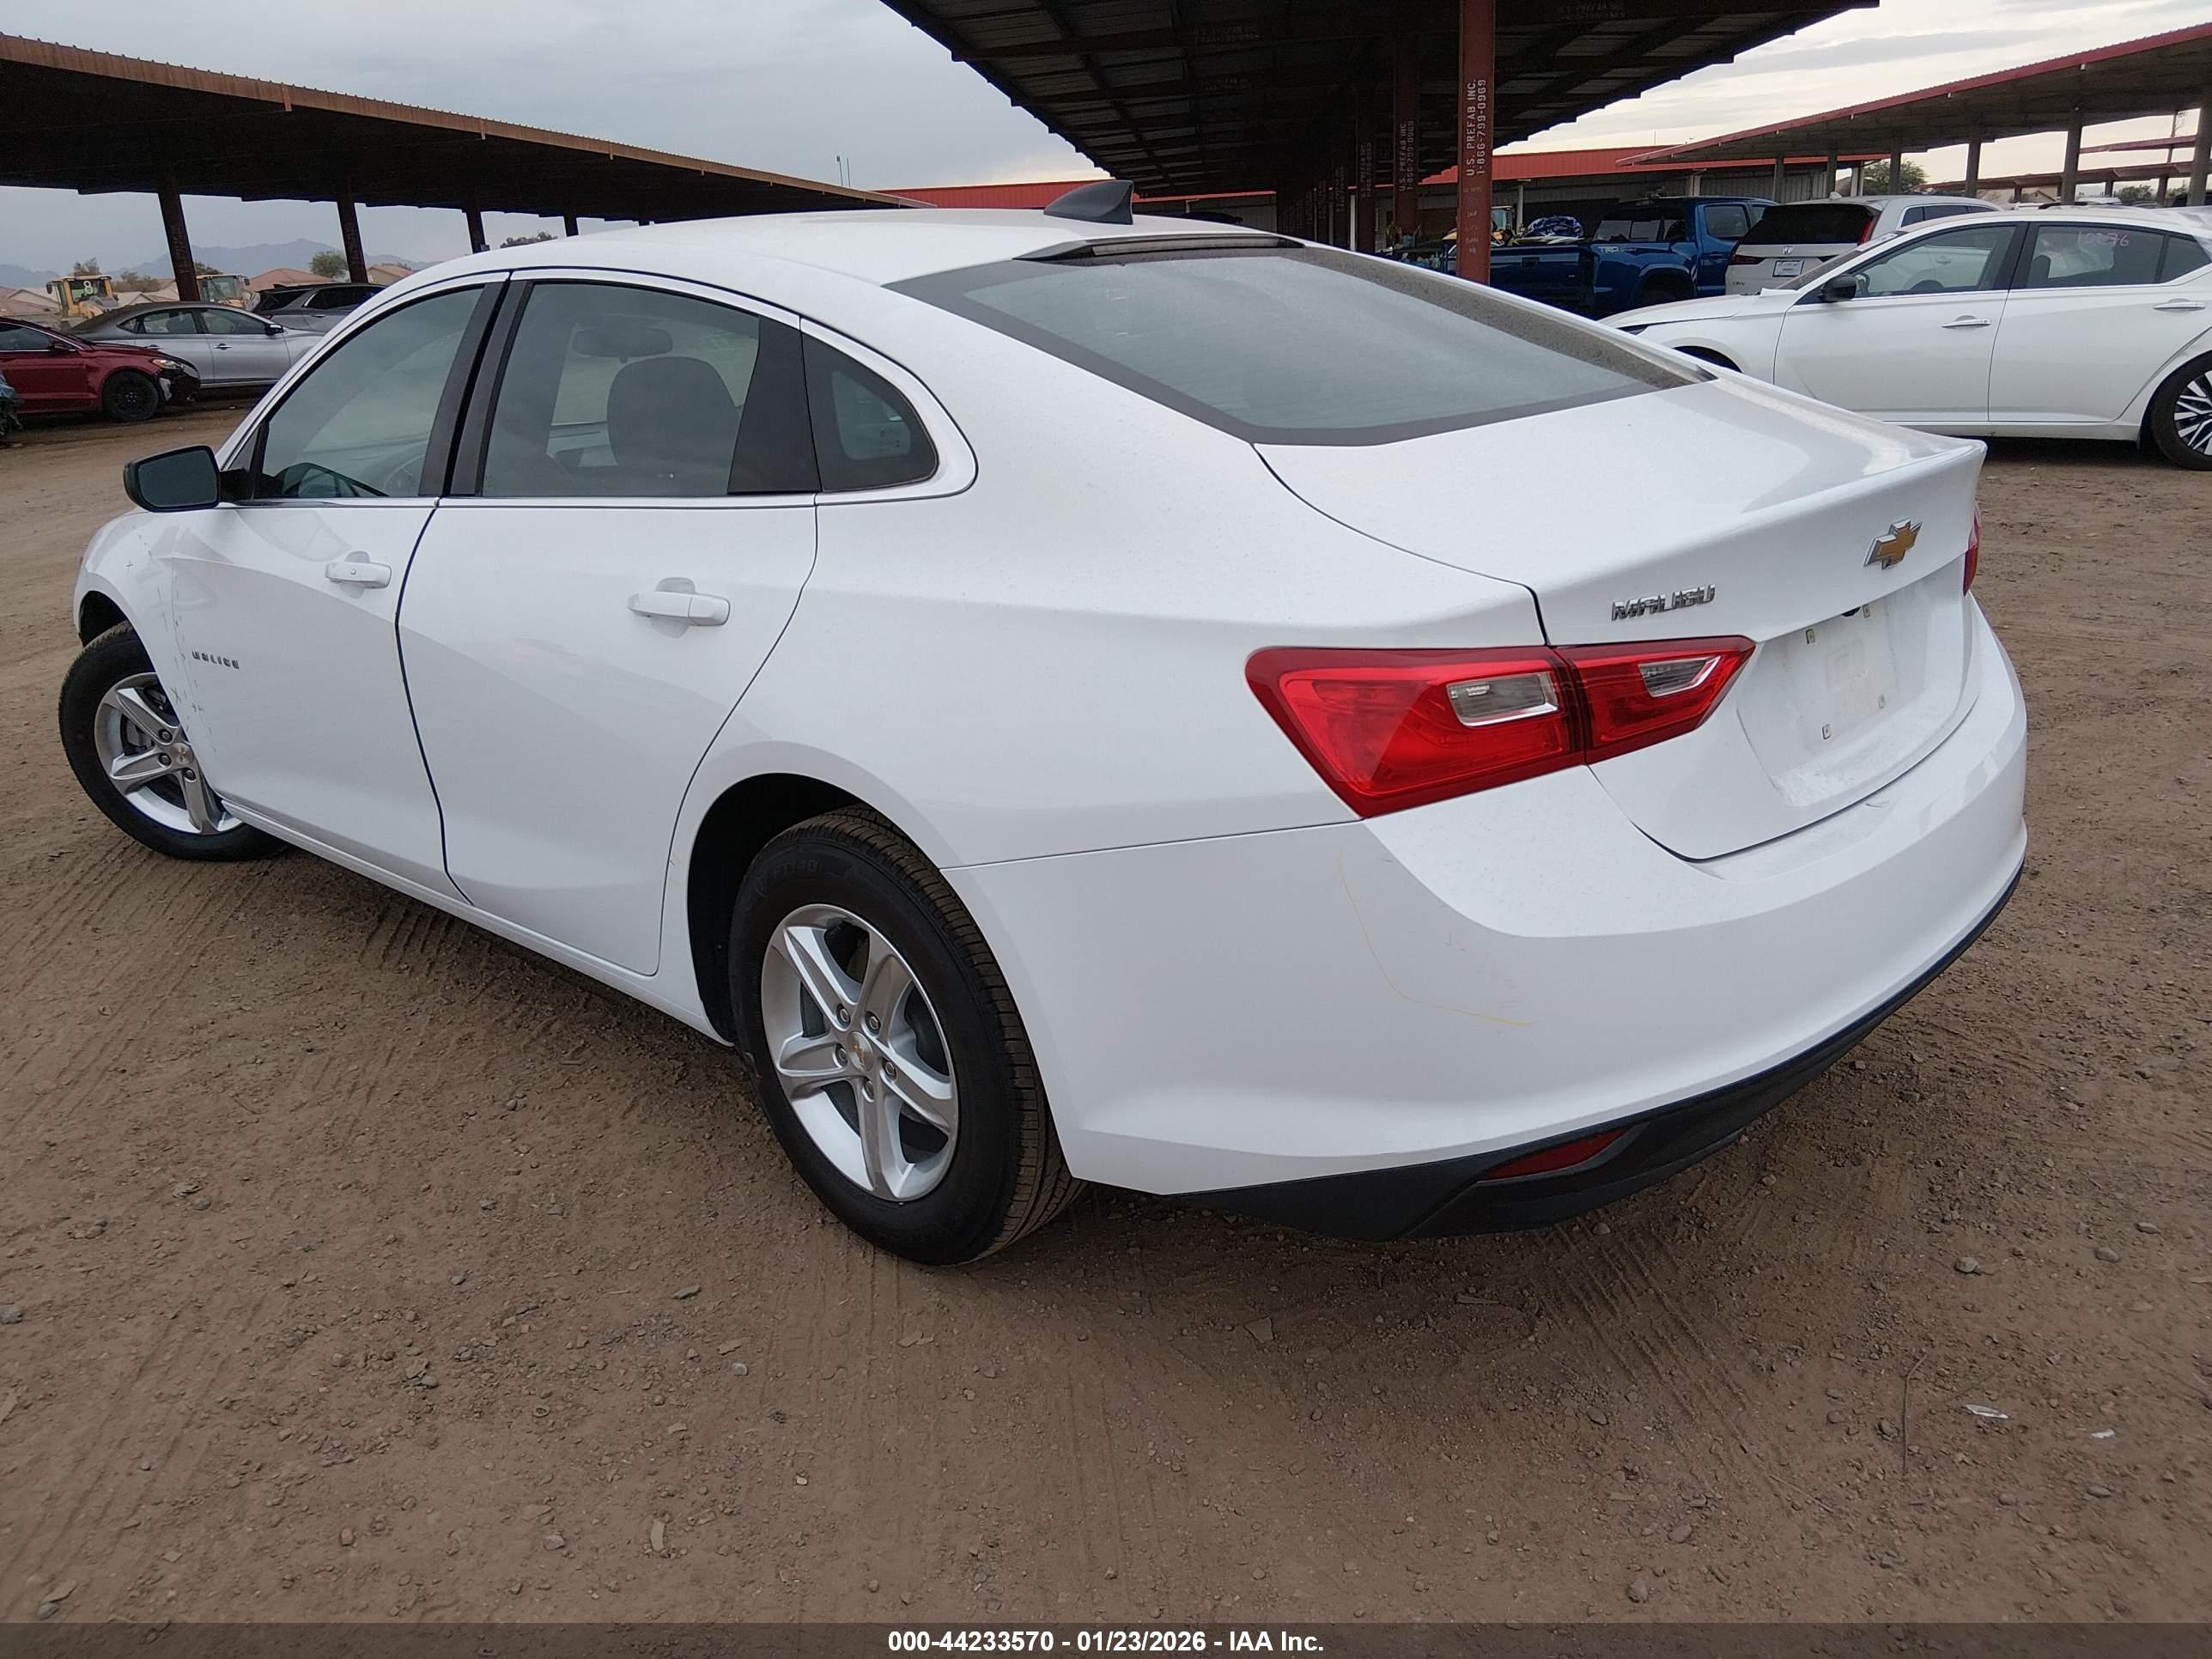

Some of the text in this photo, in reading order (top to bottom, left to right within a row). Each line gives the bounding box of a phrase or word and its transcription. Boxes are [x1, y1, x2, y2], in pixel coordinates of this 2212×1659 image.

[1467, 79, 1476, 100] INC.
[1466, 106, 1476, 149] PREFAB
[1476, 79, 1486, 174] 1-866-799-0969
[1466, 155, 1475, 176] U.S.
[83, 280, 94, 295] 8
[1611, 584, 1716, 621] MALIBU
